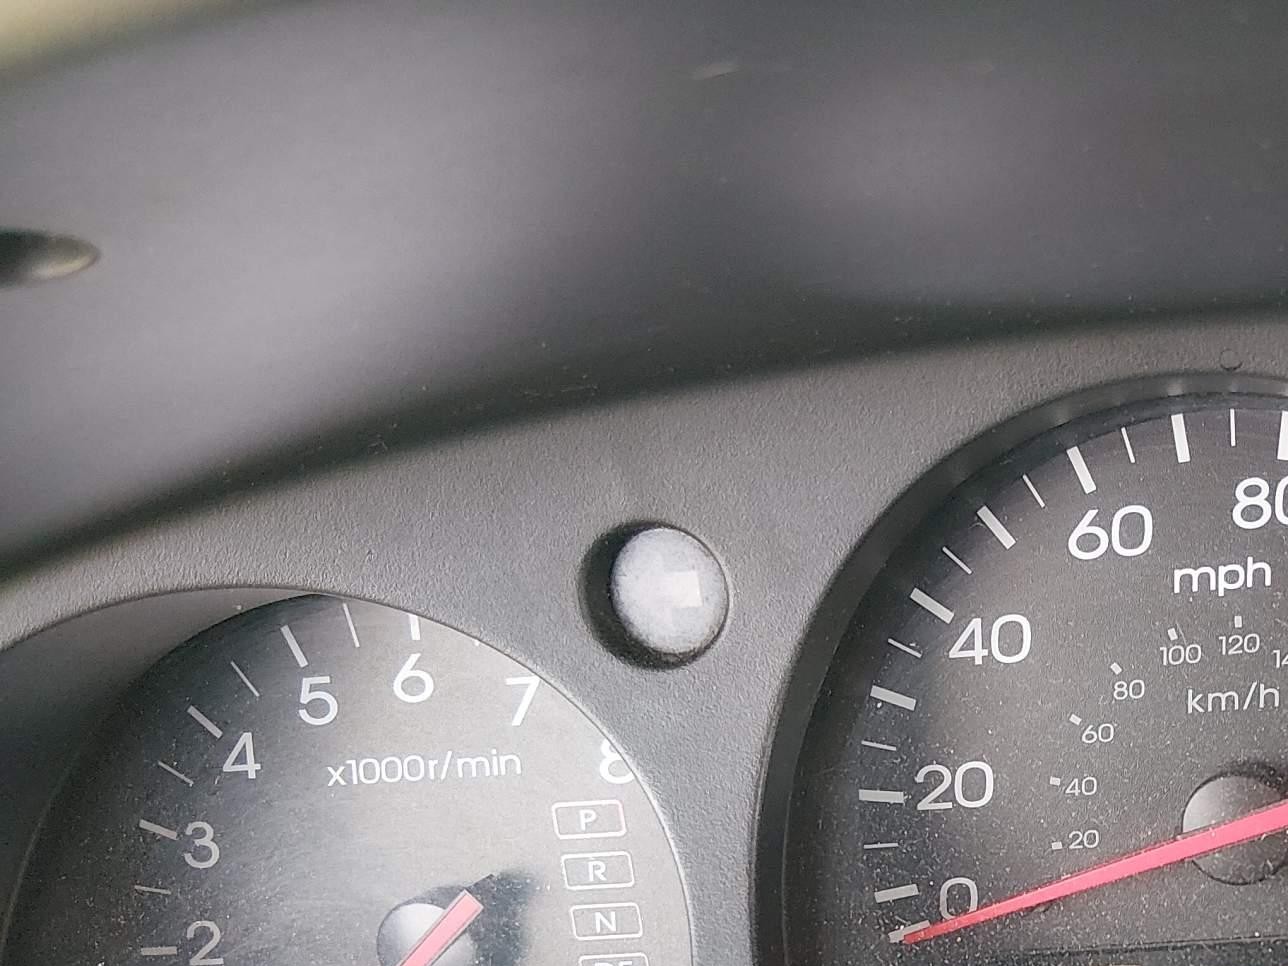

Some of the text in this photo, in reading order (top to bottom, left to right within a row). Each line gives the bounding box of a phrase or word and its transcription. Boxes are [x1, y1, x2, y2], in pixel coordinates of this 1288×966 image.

[1067, 504, 1154, 561] 60
[1173, 556, 1272, 597] mph
[948, 613, 1032, 665] 40
[1159, 644, 1202, 666] 100
[1218, 633, 1261, 656] 120
[392, 653, 435, 702] 6
[1112, 679, 1146, 701] 80
[1187, 682, 1281, 713] km/h
[297, 676, 339, 725] 5
[505, 675, 541, 726] 7
[1081, 723, 1115, 745] 60
[222, 732, 262, 779] 4
[914, 761, 995, 811] 20
[1065, 776, 1098, 797] 40
[579, 809, 597, 831] P
[1068, 829, 1100, 849] 20
[183, 821, 220, 869] 3
[587, 860, 607, 882] R
[939, 877, 978, 921] 0
[594, 911, 617, 934] N
[186, 921, 225, 966] 2
